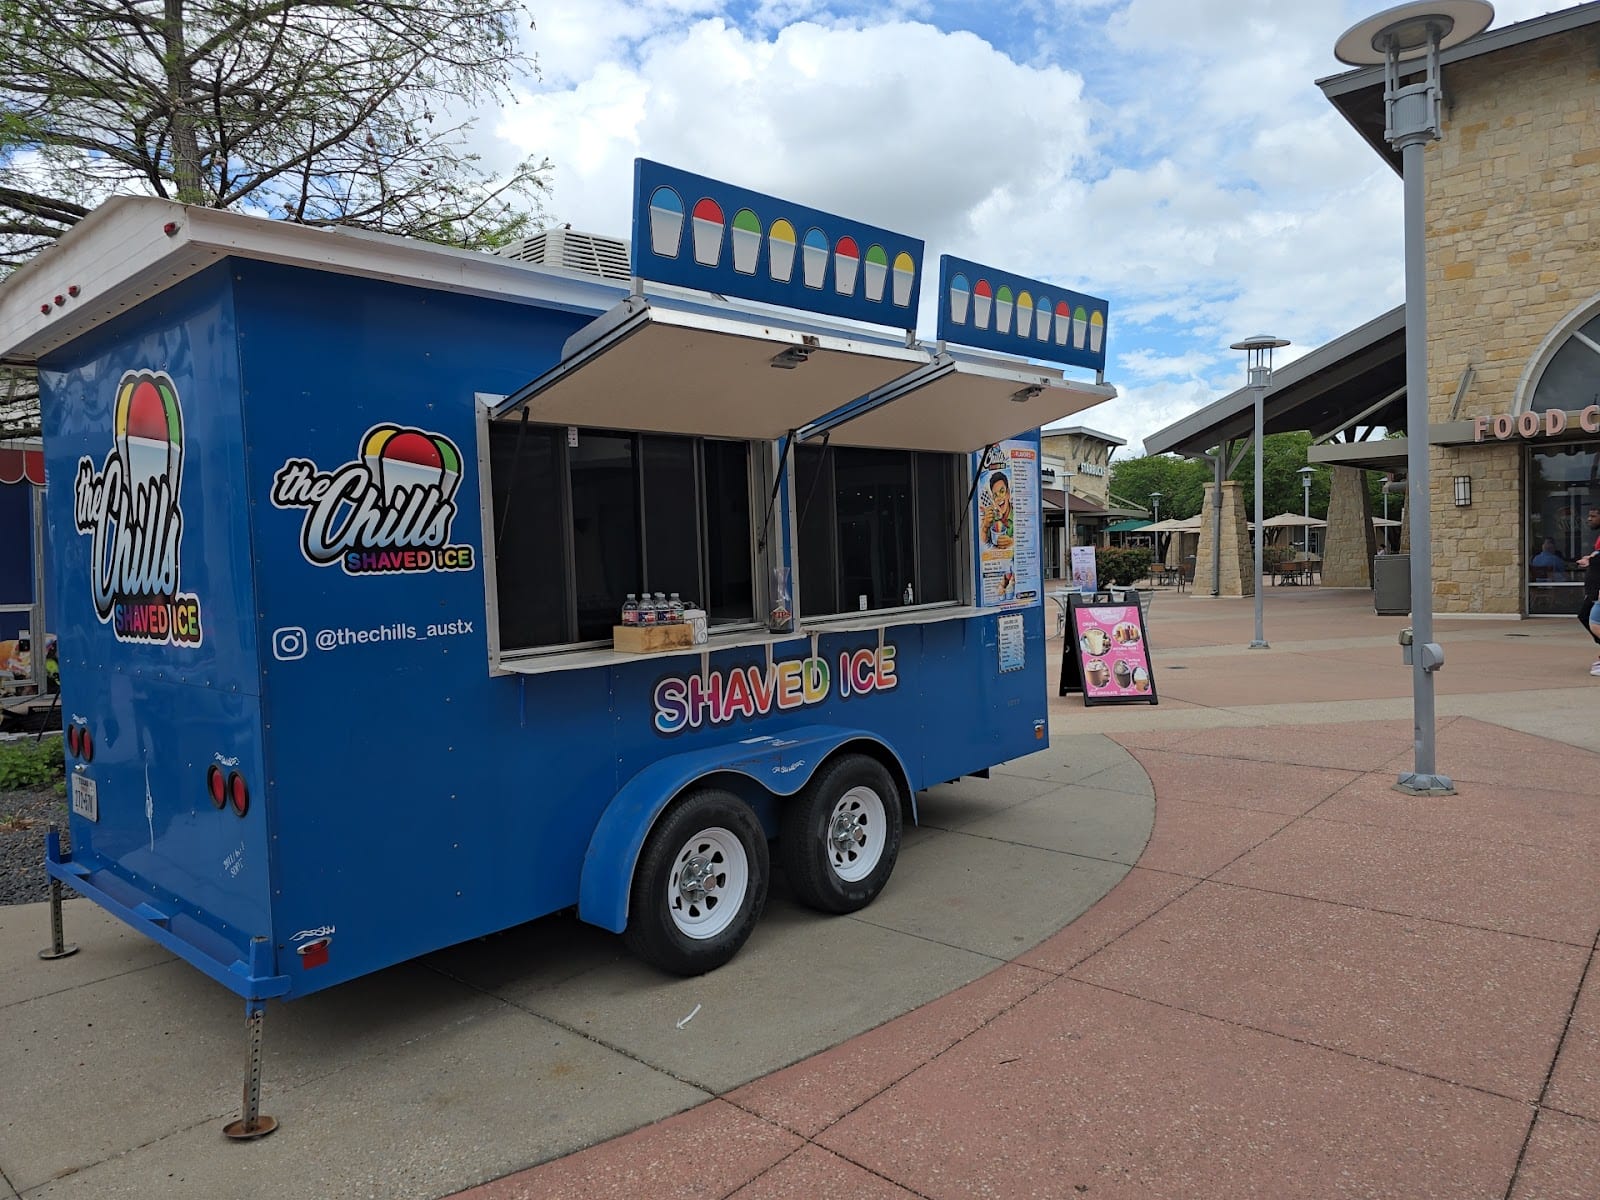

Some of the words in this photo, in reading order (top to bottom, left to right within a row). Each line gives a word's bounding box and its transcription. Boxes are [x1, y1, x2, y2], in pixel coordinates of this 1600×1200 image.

[1475, 409, 1567, 442] FOOD
[77, 467, 102, 522] the
[278, 464, 331, 501] the
[308, 466, 452, 559] Chills
[96, 460, 179, 610] Chills
[347, 550, 431, 571] SHAVED
[438, 549, 470, 567] ICE
[115, 604, 168, 634] SHAVED
[172, 605, 198, 636] ICE
[315, 618, 474, 650] @thechills_austx
[654, 657, 830, 733] SHAVED
[840, 645, 898, 697] ICE
